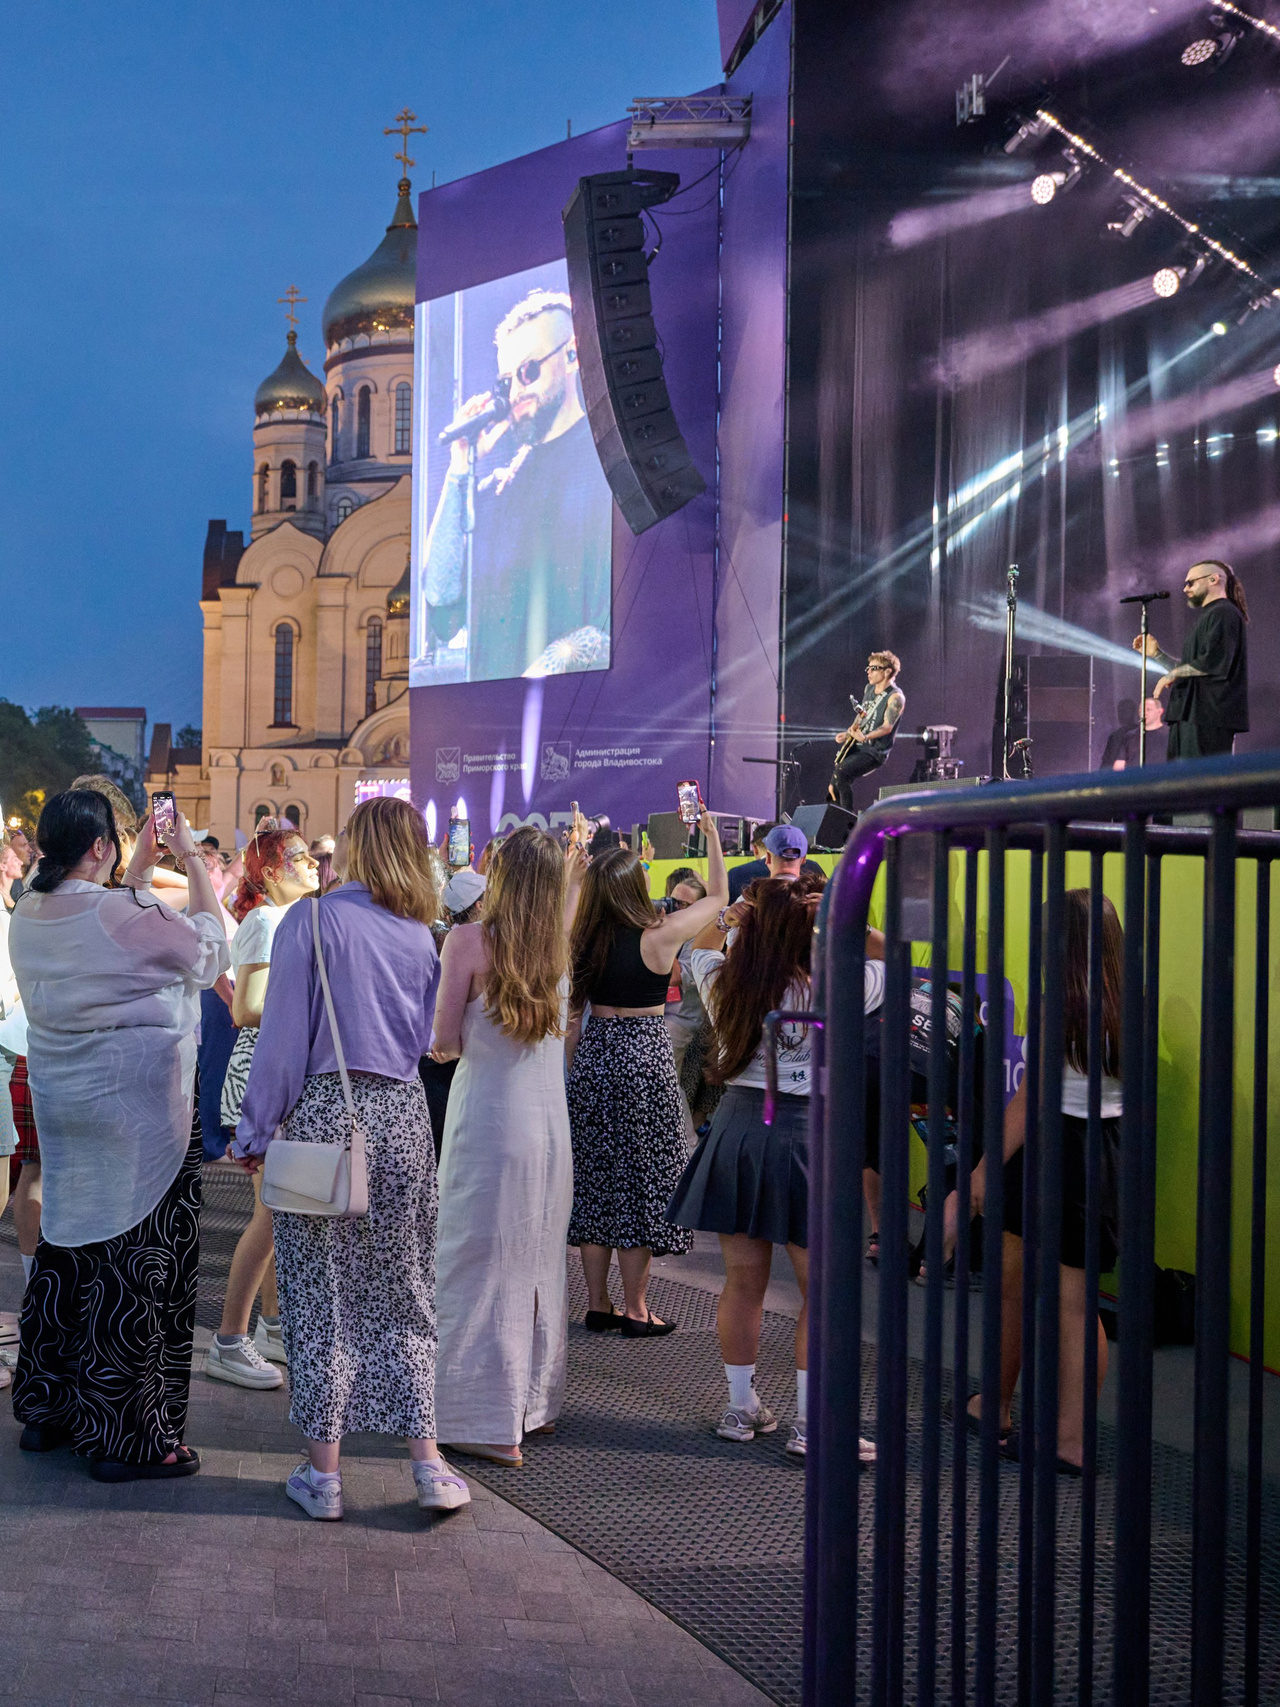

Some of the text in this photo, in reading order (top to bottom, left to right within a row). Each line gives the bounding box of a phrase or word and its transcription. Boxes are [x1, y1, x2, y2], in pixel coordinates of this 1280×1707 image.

[575, 747, 640, 758] Администрация
[463, 753, 516, 764] Правительство
[574, 758, 663, 770] города Владивостока
[462, 763, 509, 774] Приморского
[779, 1045, 812, 1063] Club
